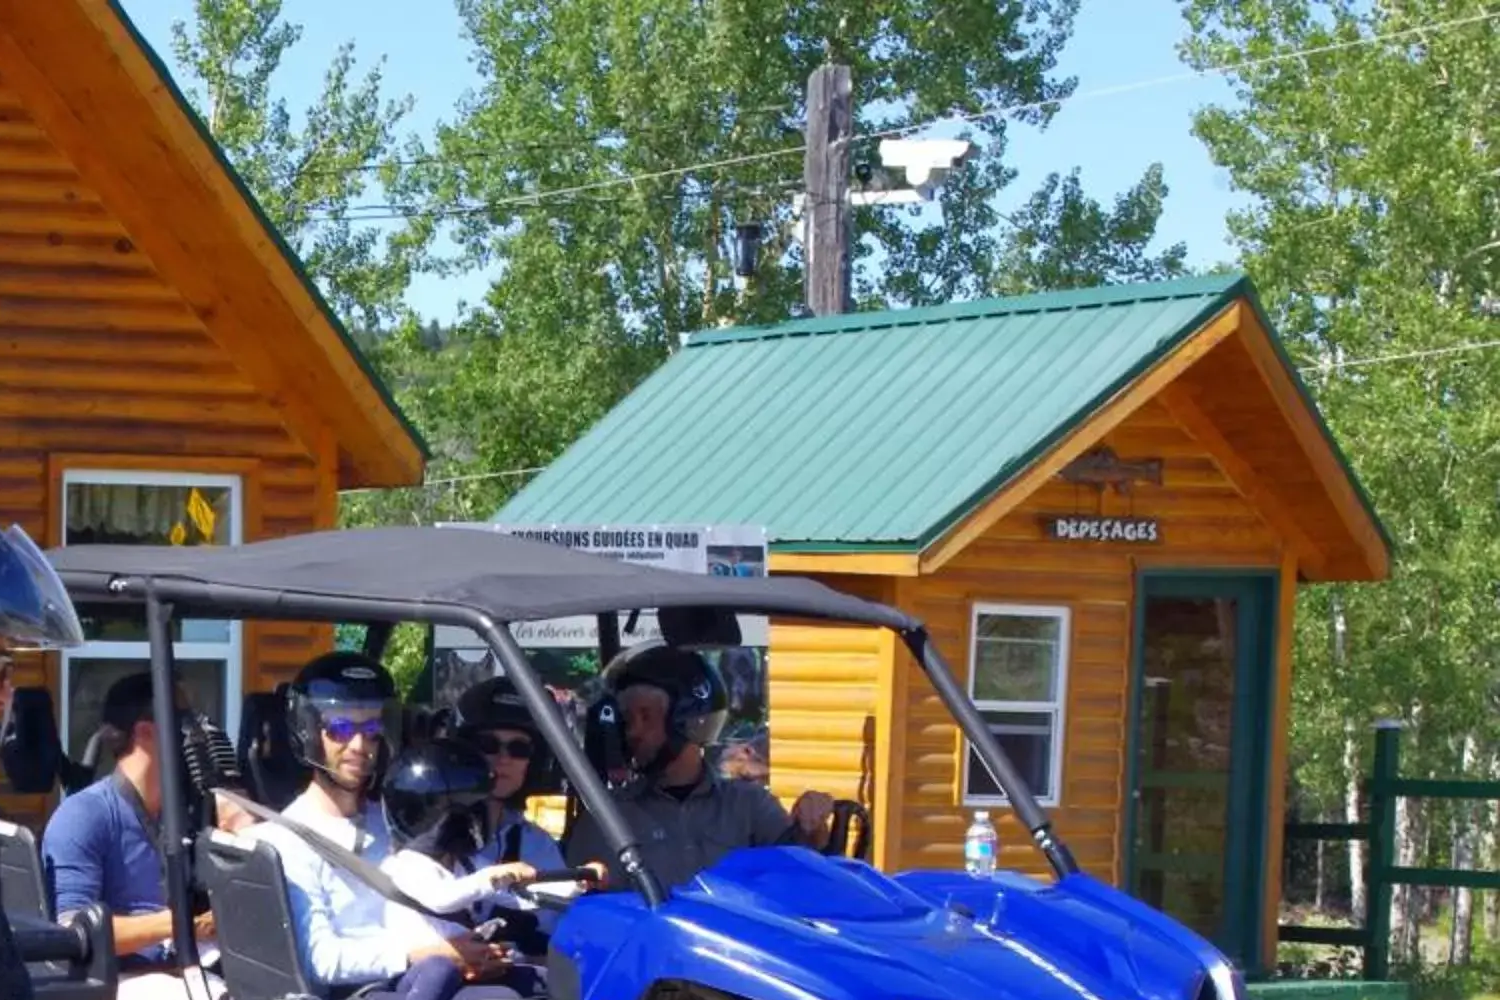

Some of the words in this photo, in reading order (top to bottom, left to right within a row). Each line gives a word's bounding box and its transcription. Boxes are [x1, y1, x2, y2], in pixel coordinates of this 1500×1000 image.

[593, 530, 645, 548] GUIDÉES
[648, 532, 663, 548] EN
[665, 532, 699, 549] QUAD
